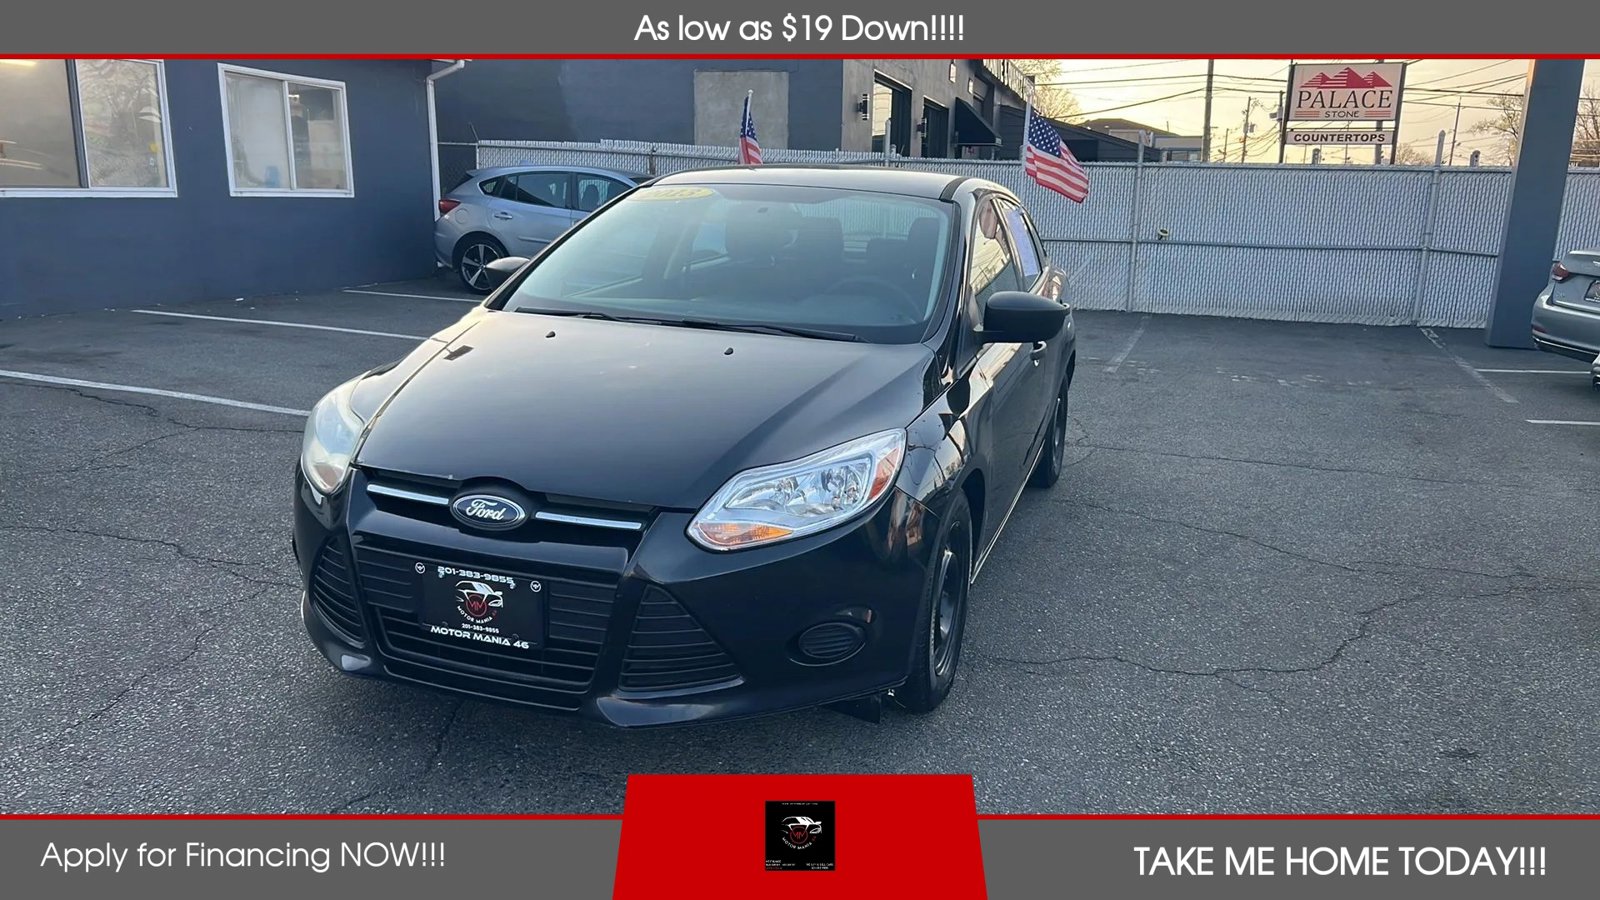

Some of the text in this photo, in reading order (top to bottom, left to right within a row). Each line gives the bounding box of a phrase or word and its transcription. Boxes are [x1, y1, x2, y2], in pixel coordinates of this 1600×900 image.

[1296, 90, 1393, 109] PALACE
[1324, 110, 1360, 118] STONE
[1293, 133, 1386, 142] COUNTERTOPS
[466, 499, 507, 521] Ford
[437, 566, 514, 584] 201-383-9855
[457, 605, 493, 624] MOTOR MANIA
[430, 625, 530, 650] MOTOR MANIA 46
